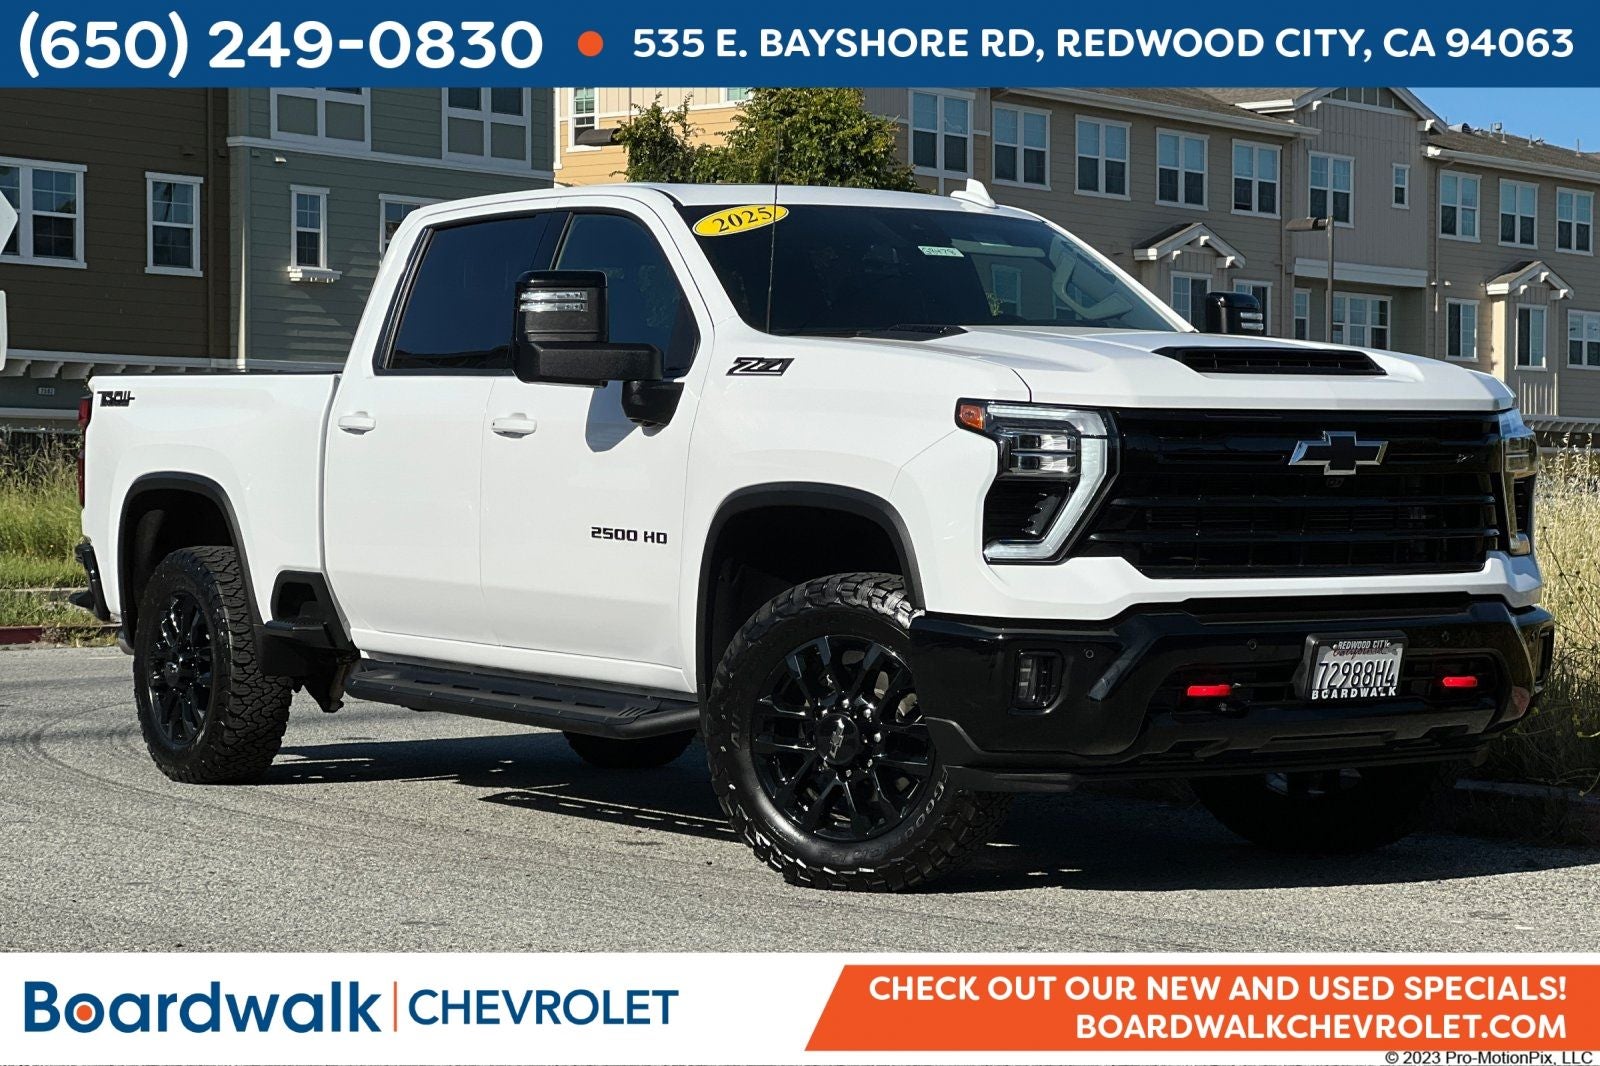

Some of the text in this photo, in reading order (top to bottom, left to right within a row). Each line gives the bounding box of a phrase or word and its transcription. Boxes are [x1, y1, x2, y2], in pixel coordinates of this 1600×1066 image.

[711, 206, 772, 233] 2025
[591, 526, 668, 544] 2500 HD
[1338, 640, 1389, 650] REDWOOD CITY
[1318, 659, 1396, 689] 72988H4
